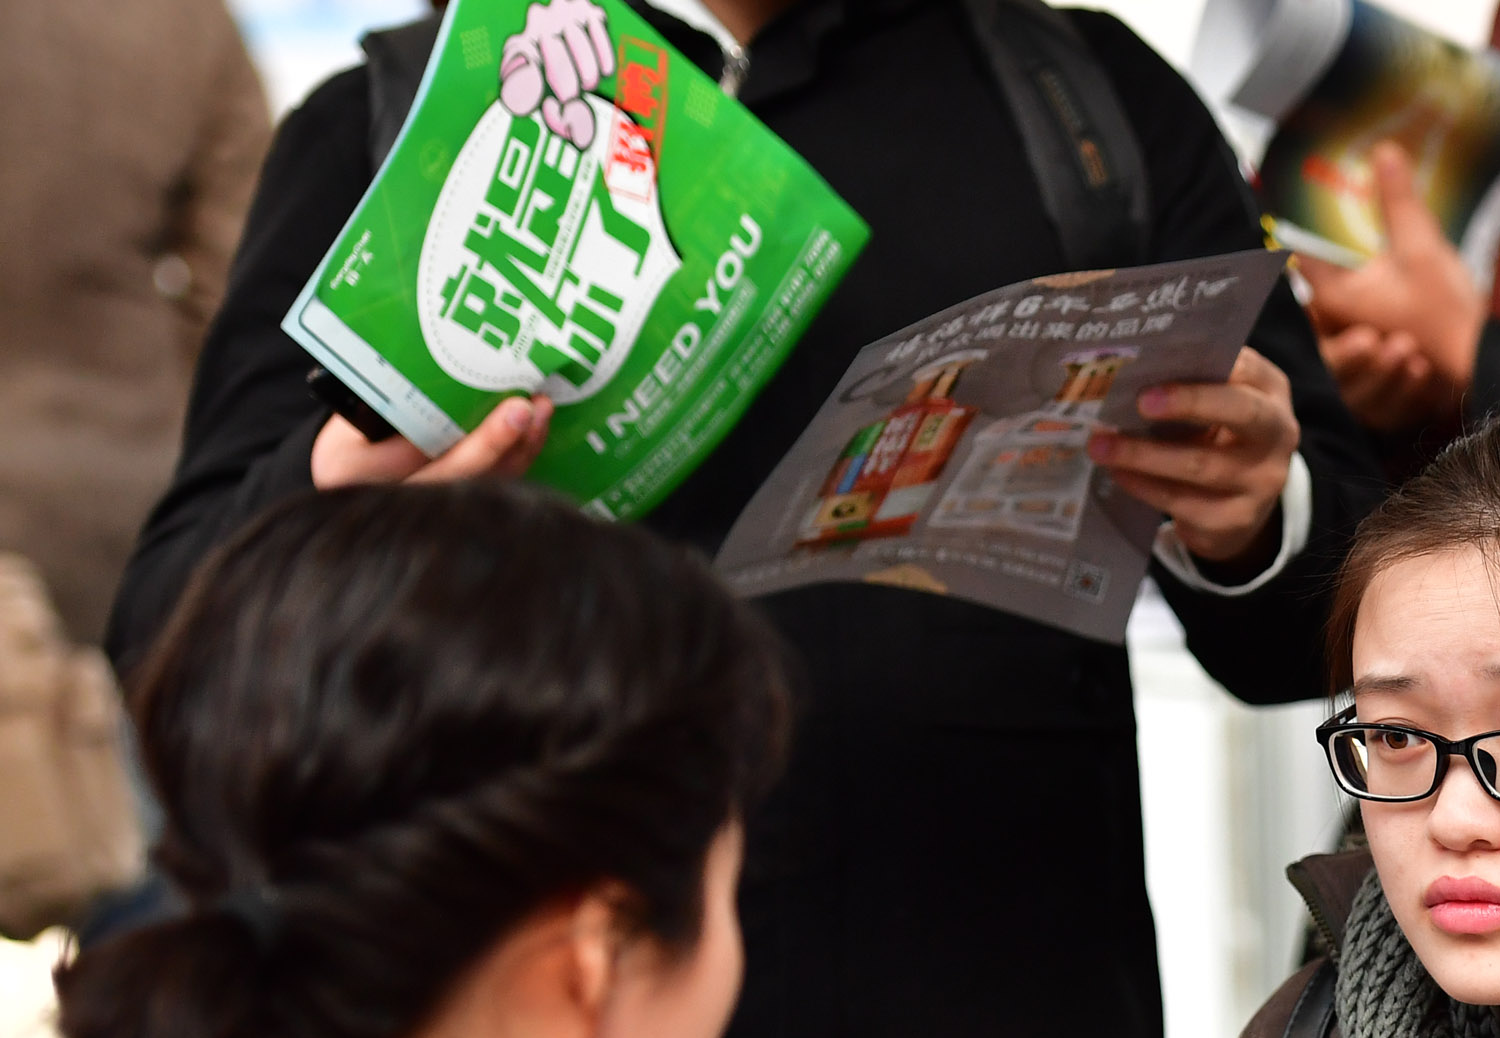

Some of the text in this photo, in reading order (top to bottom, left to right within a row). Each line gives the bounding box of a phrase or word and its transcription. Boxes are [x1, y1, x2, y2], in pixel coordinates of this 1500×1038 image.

[586, 430, 606, 454] I
[605, 321, 702, 438] NEED
[693, 212, 763, 316] YOU
